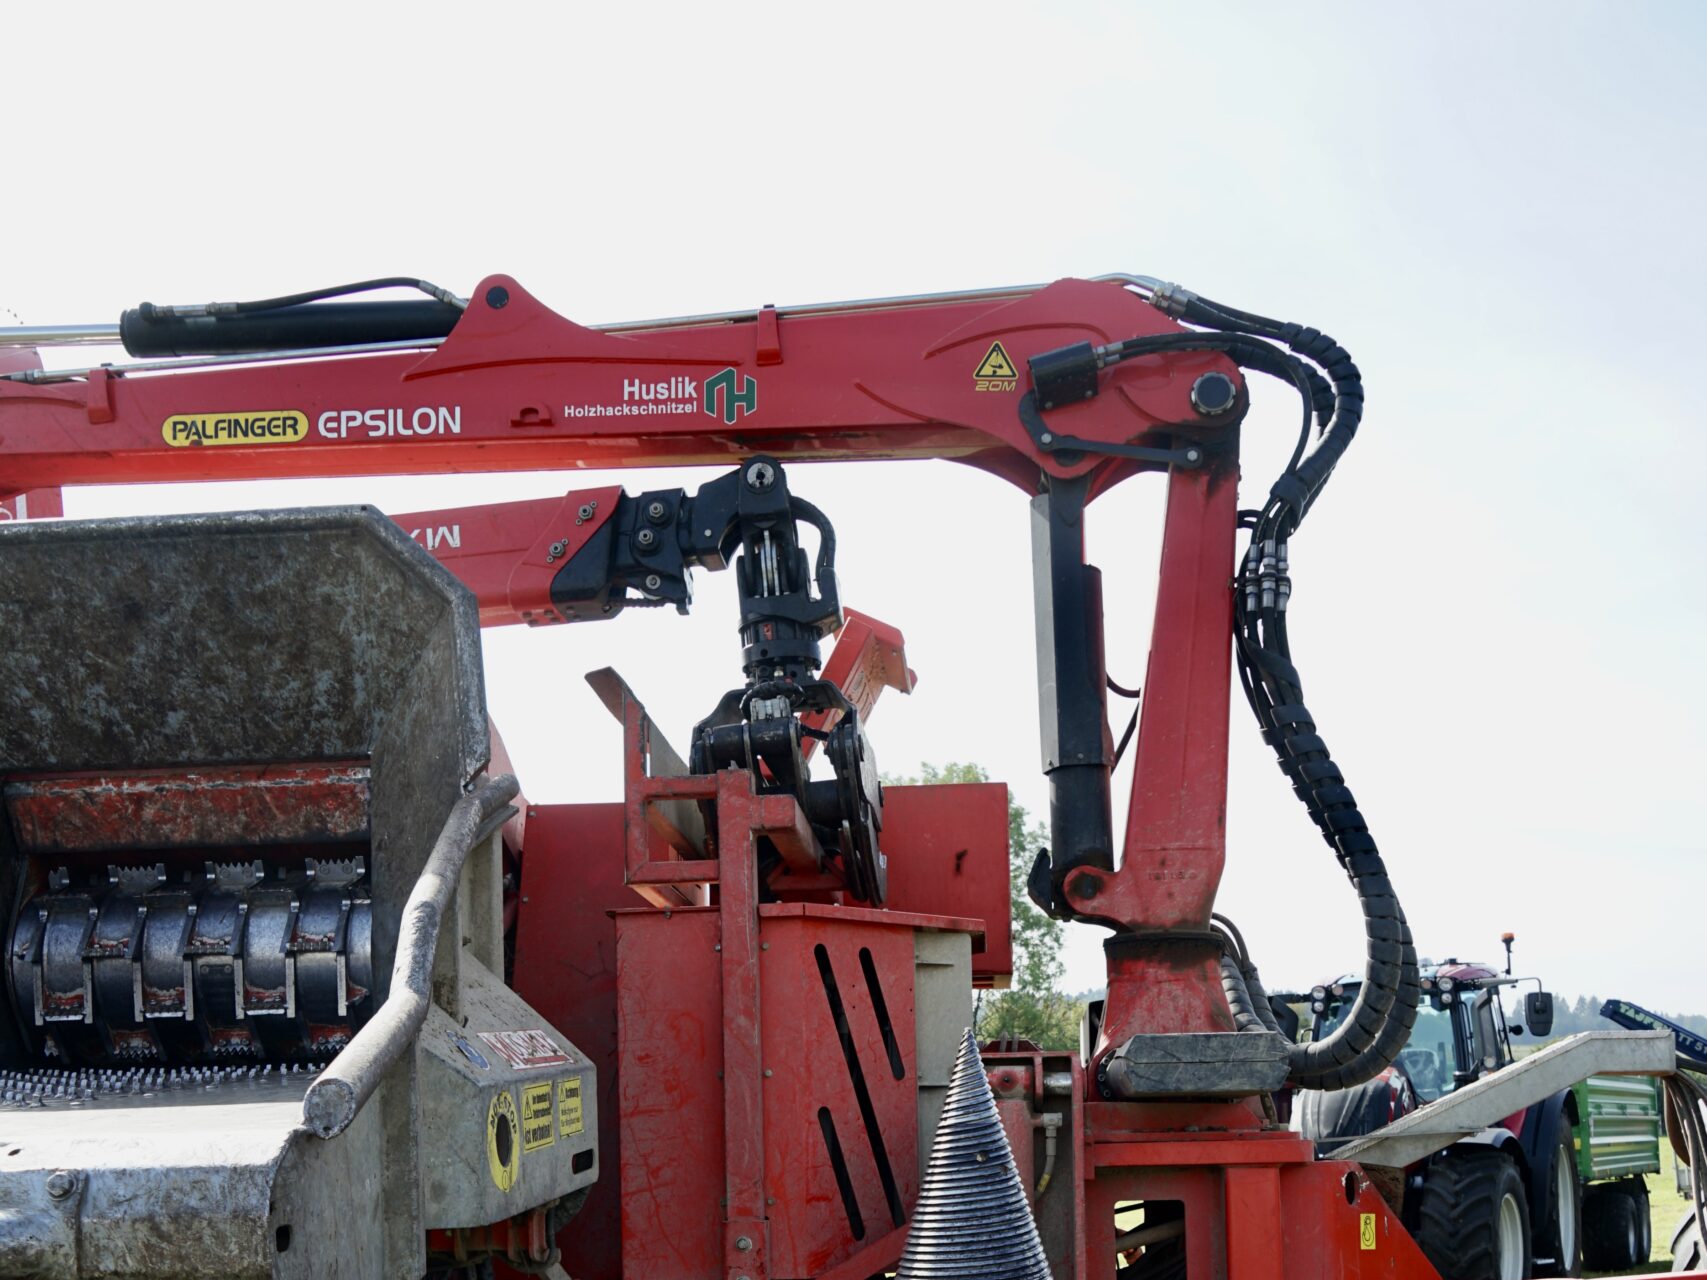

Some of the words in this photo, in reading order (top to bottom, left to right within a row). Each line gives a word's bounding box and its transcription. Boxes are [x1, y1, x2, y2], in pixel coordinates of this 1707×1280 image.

[623, 376, 698, 401] Huslik
[974, 380, 1016, 392] 20M
[564, 401, 697, 417] Holzhackschnitzel
[172, 416, 299, 440] PALFINGER
[318, 406, 461, 439] EPSILON
